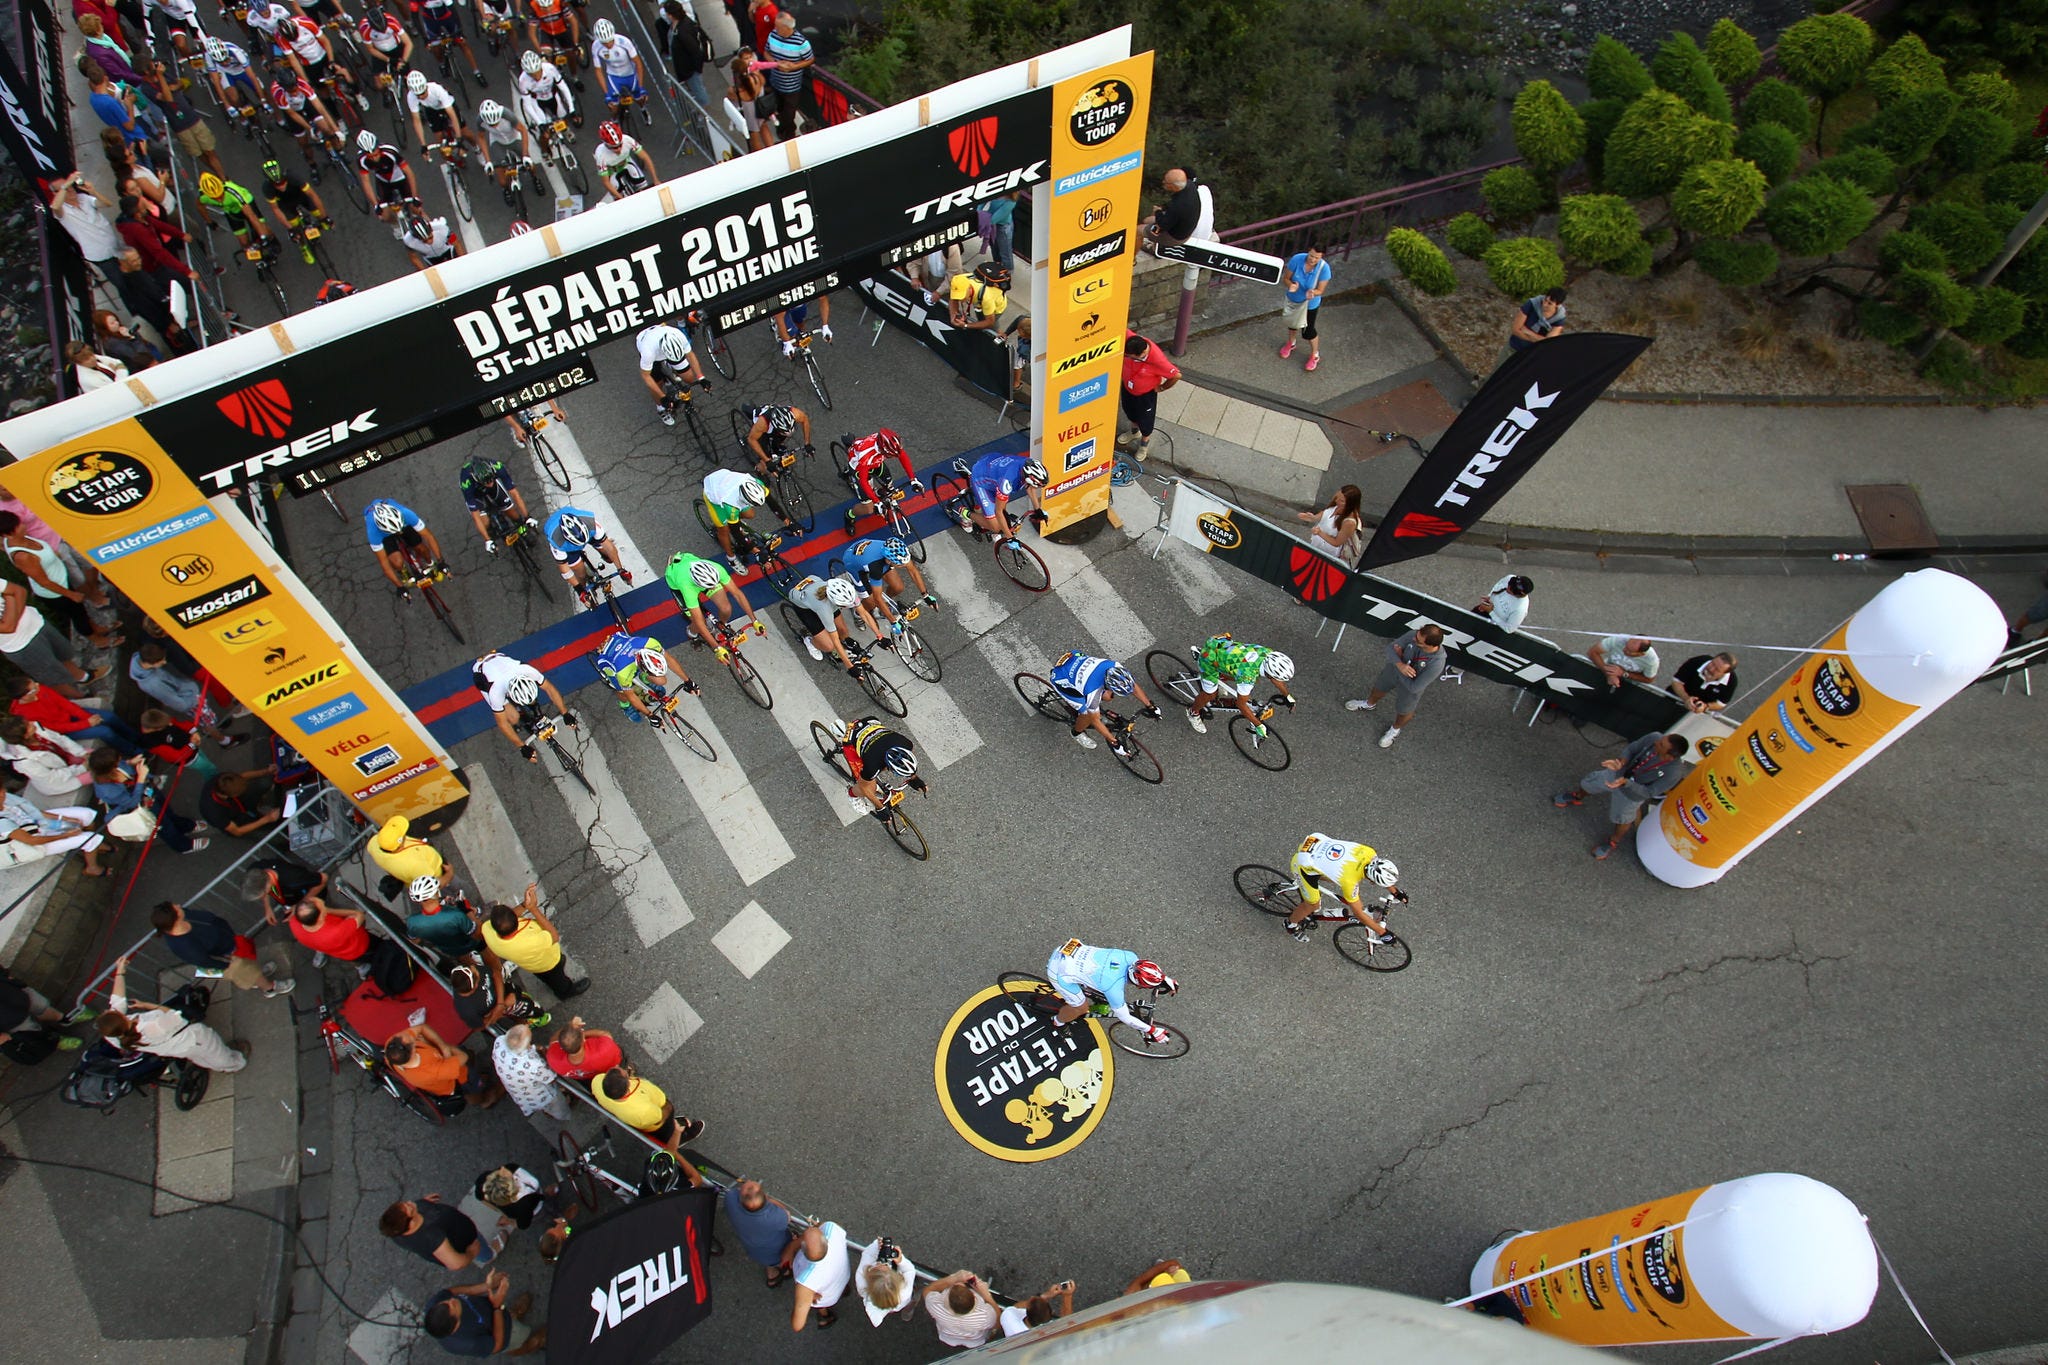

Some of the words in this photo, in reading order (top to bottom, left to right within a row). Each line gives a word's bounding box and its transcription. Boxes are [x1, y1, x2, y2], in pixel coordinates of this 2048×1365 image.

[1077, 102, 1126, 128] L'ÉTAPE
[1085, 122, 1117, 142] TOUR
[905, 159, 1047, 225] TREK
[1058, 158, 1138, 191] Alltricks.com
[889, 220, 970, 263] 7:40:00
[453, 243, 664, 360] DÉPART
[681, 190, 815, 273] 2015
[1220, 258, 1257, 274] Arvan
[1076, 278, 1110, 297] LCL
[475, 235, 820, 383] ST-JEAN-DE-MAURIENNE
[1056, 340, 1117, 374] MAVIC
[491, 366, 588, 413] 7:40:02
[200, 408, 380, 490] TREK
[1058, 422, 1090, 443] VÉLO
[1434, 381, 1562, 508] TREK
[340, 449, 382, 474] est
[67, 467, 140, 504] L'ÉTAPE
[93, 487, 143, 512] TOUR
[1046, 488, 1054, 497] le
[1056, 466, 1103, 492] dauphiné
[98, 511, 210, 560] Alltricks.com
[1208, 532, 1227, 545] TOUR
[223, 617, 273, 640] LCL
[1361, 593, 1596, 697] TREK
[265, 663, 339, 706] MAVIC
[1814, 683, 1835, 712] TOUR
[325, 733, 371, 758] VÉLO
[353, 790, 367, 801] le
[368, 762, 428, 795] dauphiné
[1708, 774, 1736, 812] MAVIC
[962, 1002, 1038, 1055] TOUR
[1002, 1040, 1020, 1054] DU
[1644, 1247, 1660, 1286] TOUR
[590, 1245, 689, 1345] TREK
